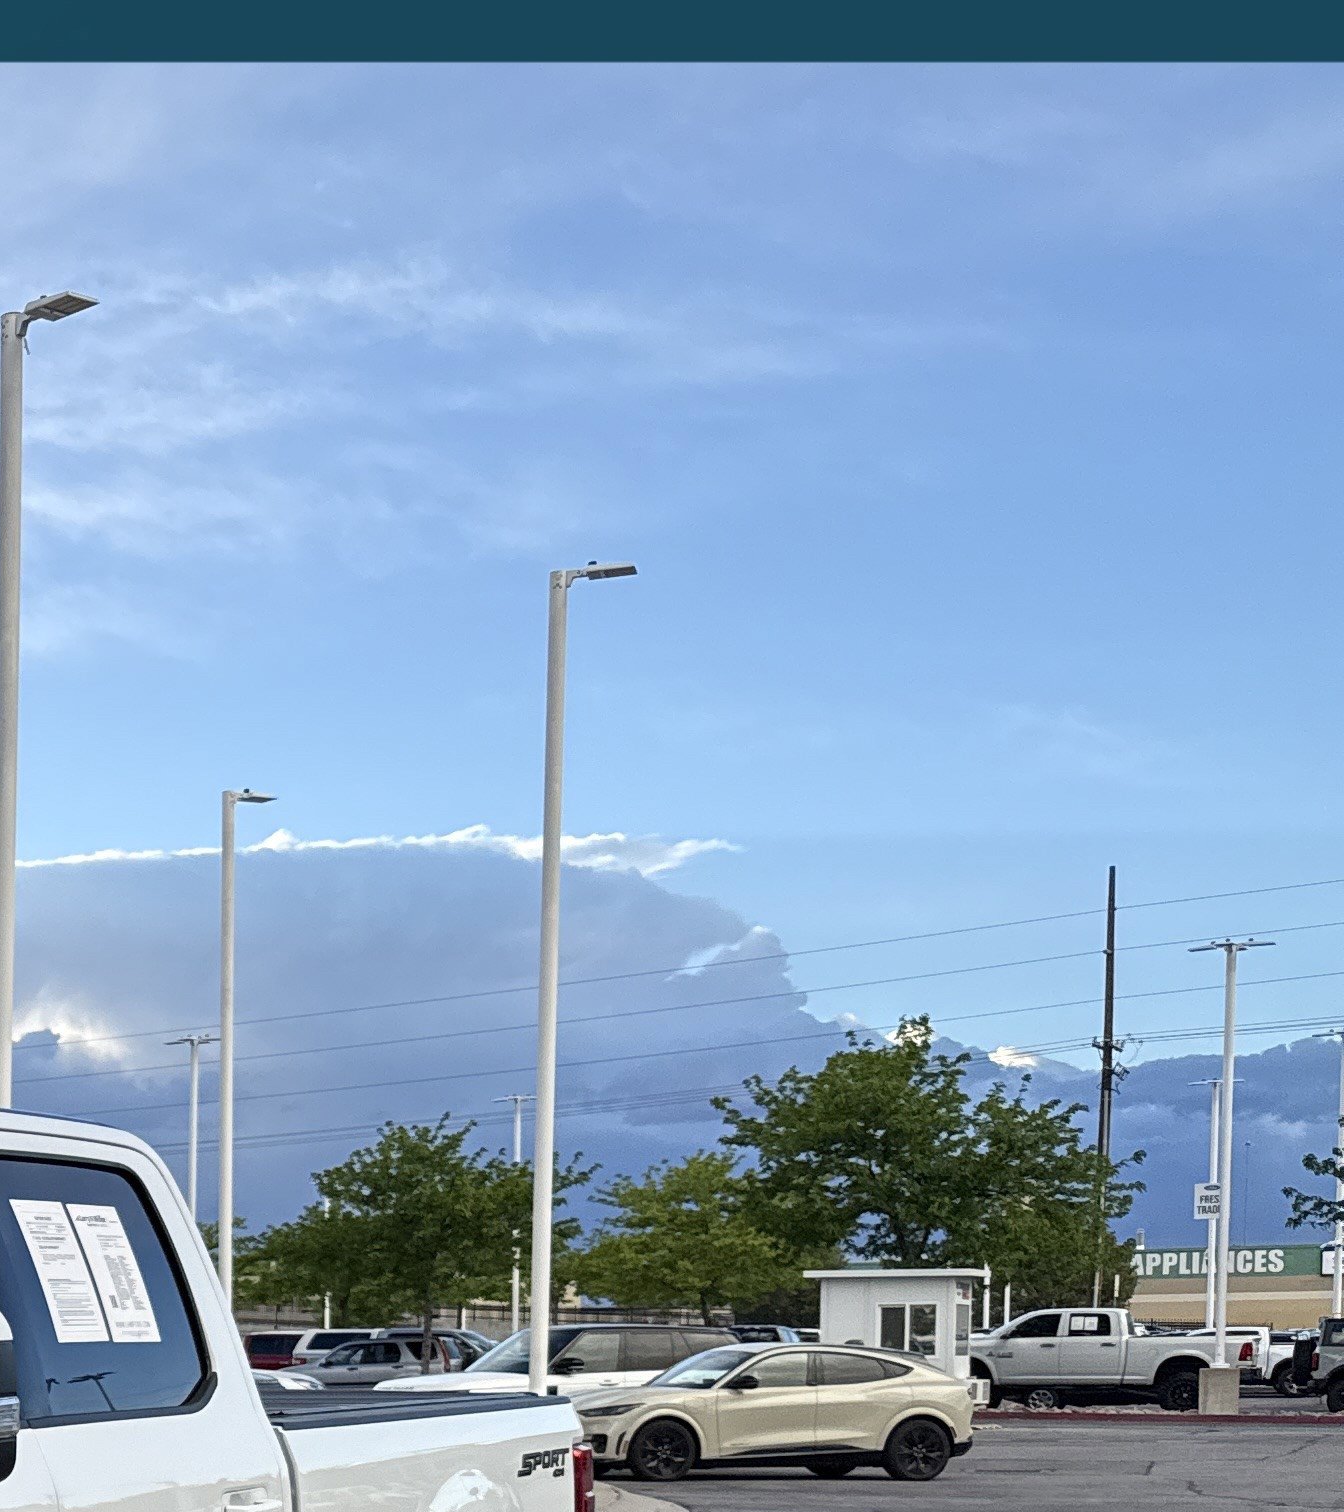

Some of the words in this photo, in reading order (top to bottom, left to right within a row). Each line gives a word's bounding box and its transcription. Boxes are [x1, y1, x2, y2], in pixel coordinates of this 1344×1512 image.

[1199, 1194, 1221, 1205] FRES
[1196, 1204, 1221, 1215] TRAD
[517, 1447, 569, 1478] SPORT
